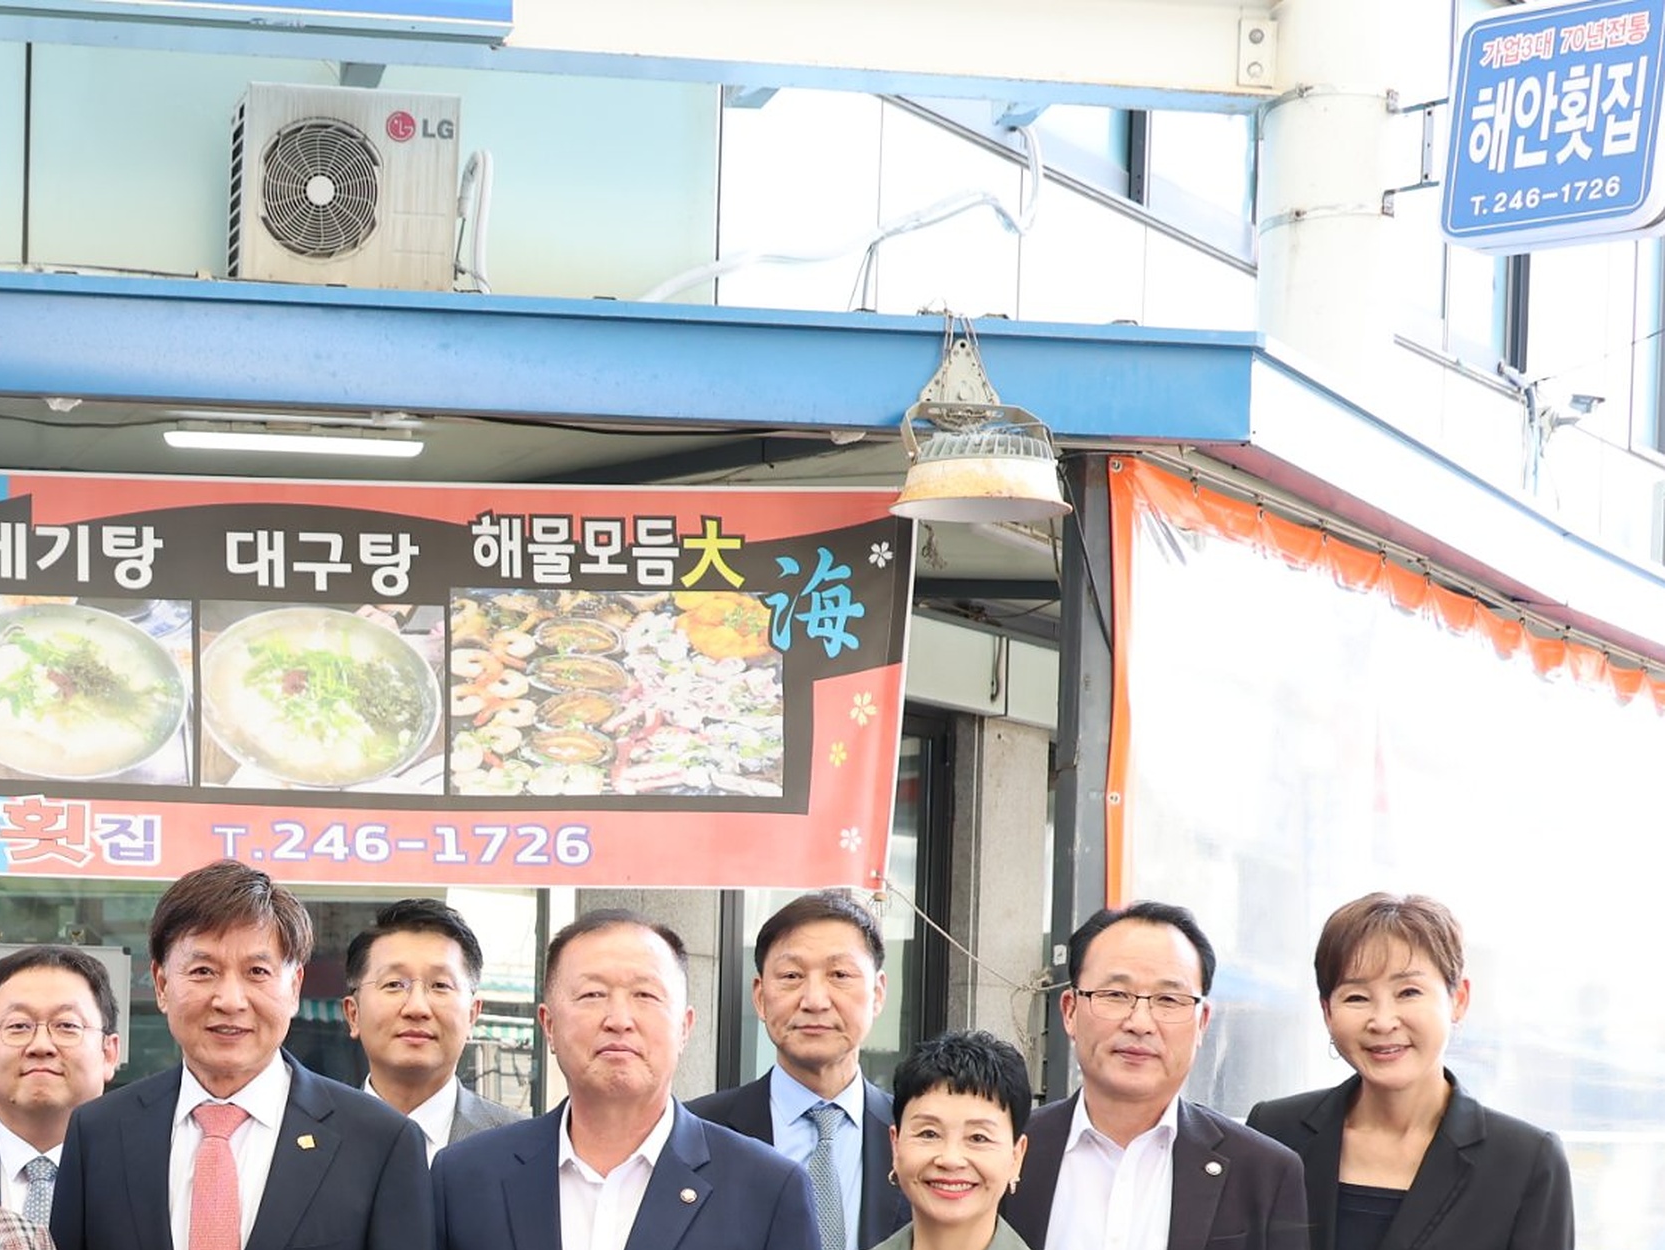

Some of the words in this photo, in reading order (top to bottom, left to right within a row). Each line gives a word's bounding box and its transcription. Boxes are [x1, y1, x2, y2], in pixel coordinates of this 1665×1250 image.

[422, 118, 454, 140] LG
[1468, 55, 1649, 173] 해안횟집
[225, 529, 420, 596] 대구탕
[765, 547, 866, 658] 海
